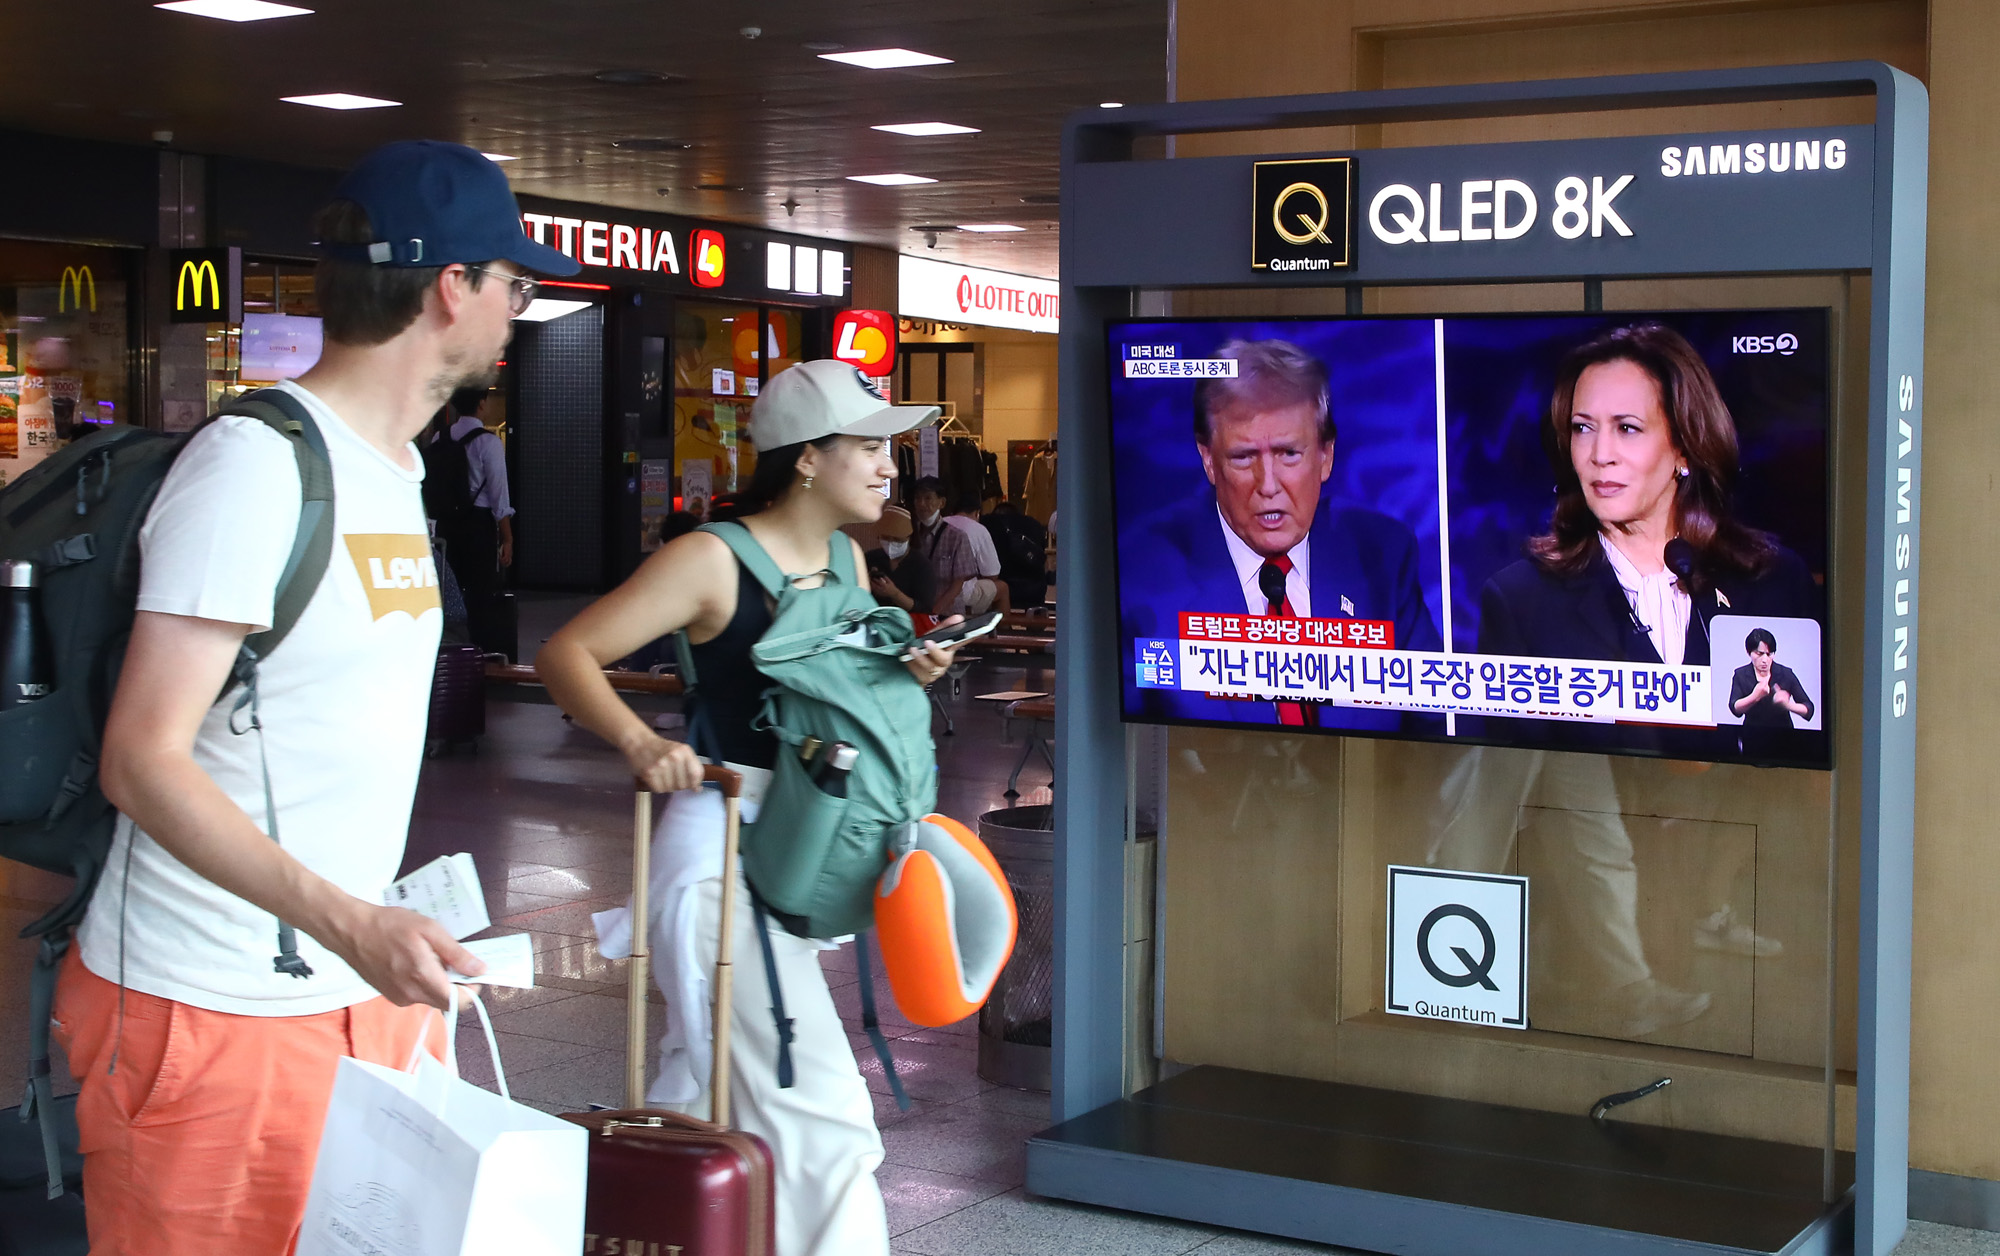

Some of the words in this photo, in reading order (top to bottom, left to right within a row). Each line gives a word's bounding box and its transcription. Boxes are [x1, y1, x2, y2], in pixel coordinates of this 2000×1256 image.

[1660, 138, 1848, 178] SAMSUNG
[1272, 181, 1334, 245] Q
[1368, 178, 1539, 245] QLED
[1551, 174, 1637, 241] 8K
[520, 212, 680, 275] TTERIA
[1269, 256, 1331, 273] Quantum
[975, 284, 1025, 313] LOTTE
[1130, 345, 1152, 358] 미국
[1153, 345, 1175, 358] 대선
[1131, 362, 1156, 375] ABC
[1158, 361, 1181, 375] 토론
[1182, 361, 1205, 375] 동시
[1207, 361, 1231, 375] 중계
[1892, 374, 1914, 718] SAMSUNG
[1149, 641, 1165, 649] KBS
[1186, 615, 1242, 638] 트럼프
[1245, 617, 1301, 644] 공화당
[1305, 620, 1344, 645] 대선
[1347, 622, 1387, 646] 후보
[1141, 649, 1174, 667] 뉴스
[1142, 667, 1175, 687] 특보
[1189, 645, 1249, 686] "지난
[1254, 650, 1355, 693] 대선에서
[1361, 656, 1413, 696] 나의
[1419, 659, 1474, 700] 주장
[1479, 661, 1563, 705] 입증할
[1568, 667, 1624, 709] 증거
[1633, 670, 1701, 713] 많아"
[1416, 903, 1501, 992] Q
[1415, 1000, 1497, 1023] Quantum
[585, 1233, 684, 1256] TSUIT
